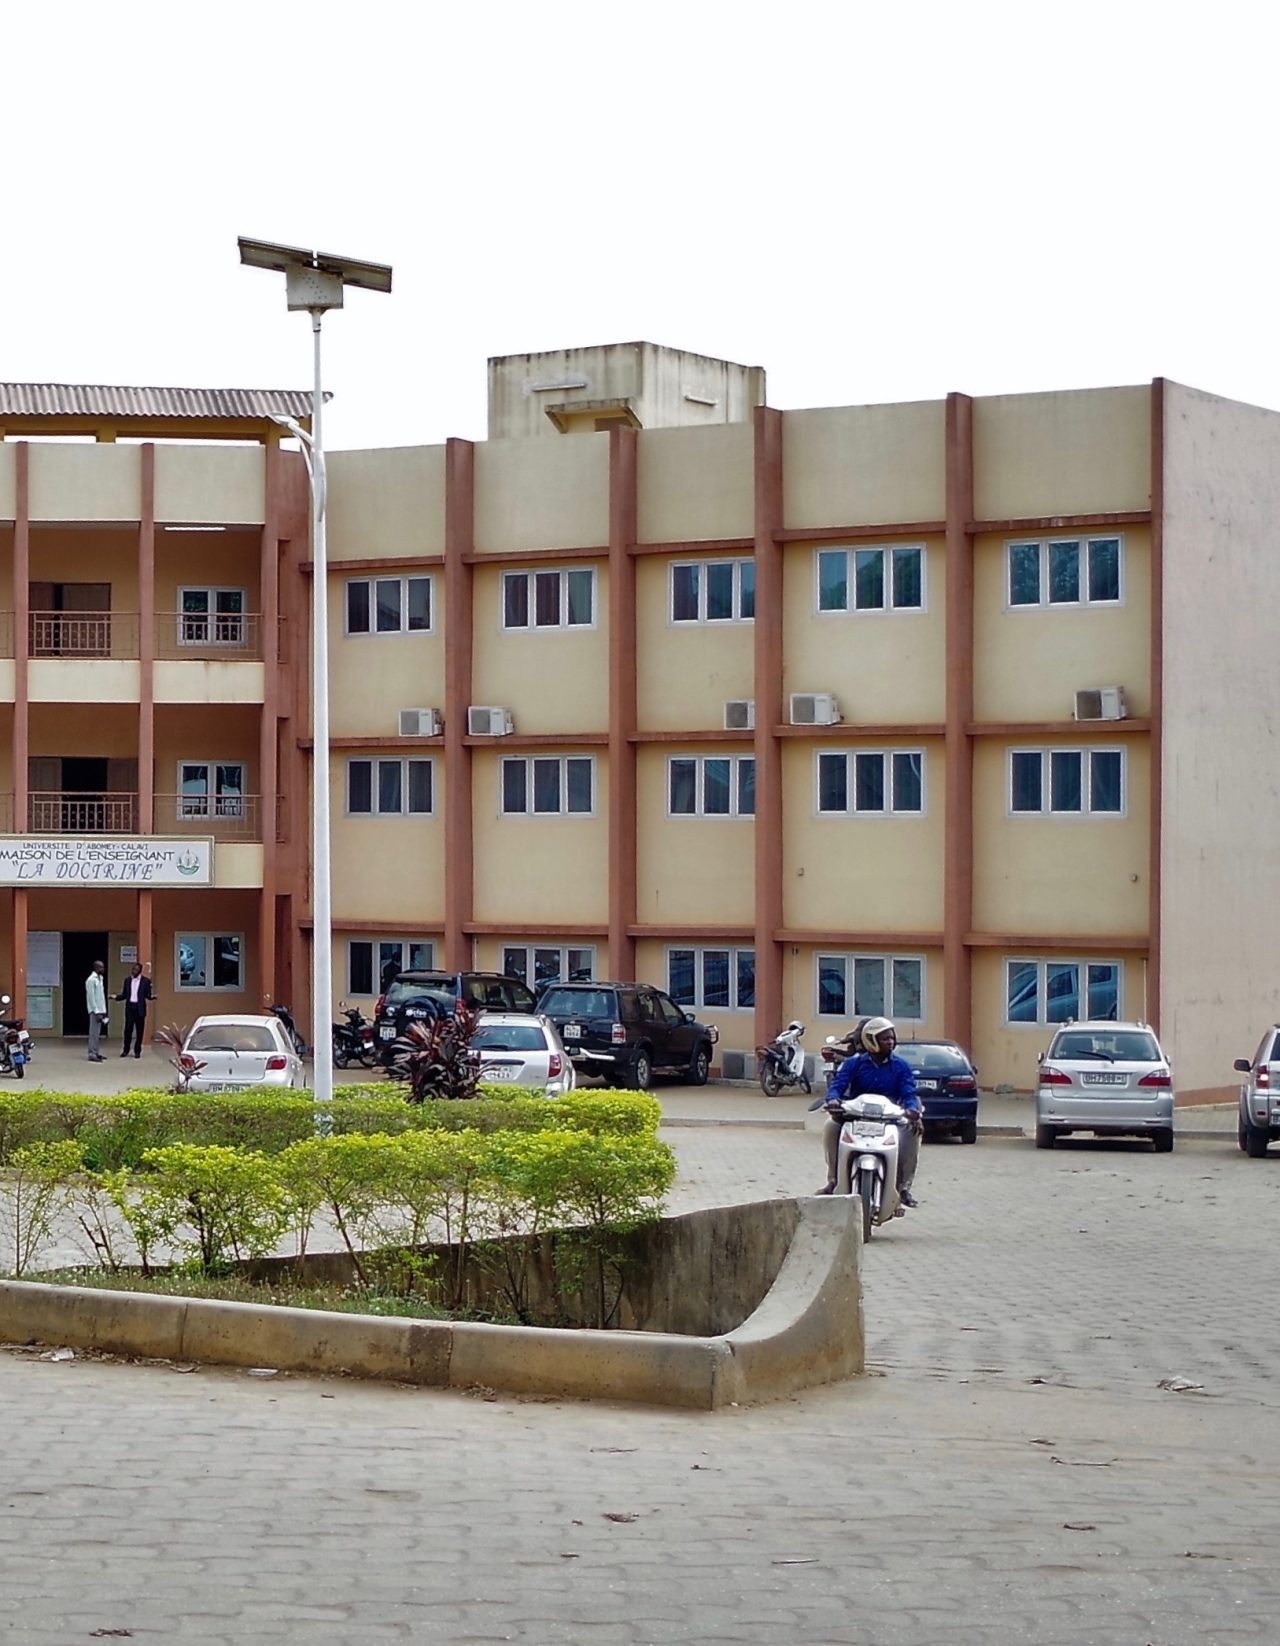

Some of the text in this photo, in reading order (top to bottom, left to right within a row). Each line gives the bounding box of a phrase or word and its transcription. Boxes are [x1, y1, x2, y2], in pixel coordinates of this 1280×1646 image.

[23, 842, 70, 850] UNIVERSITE
[0, 850, 175, 861] MAISON DE L'ENSEIGNANT
